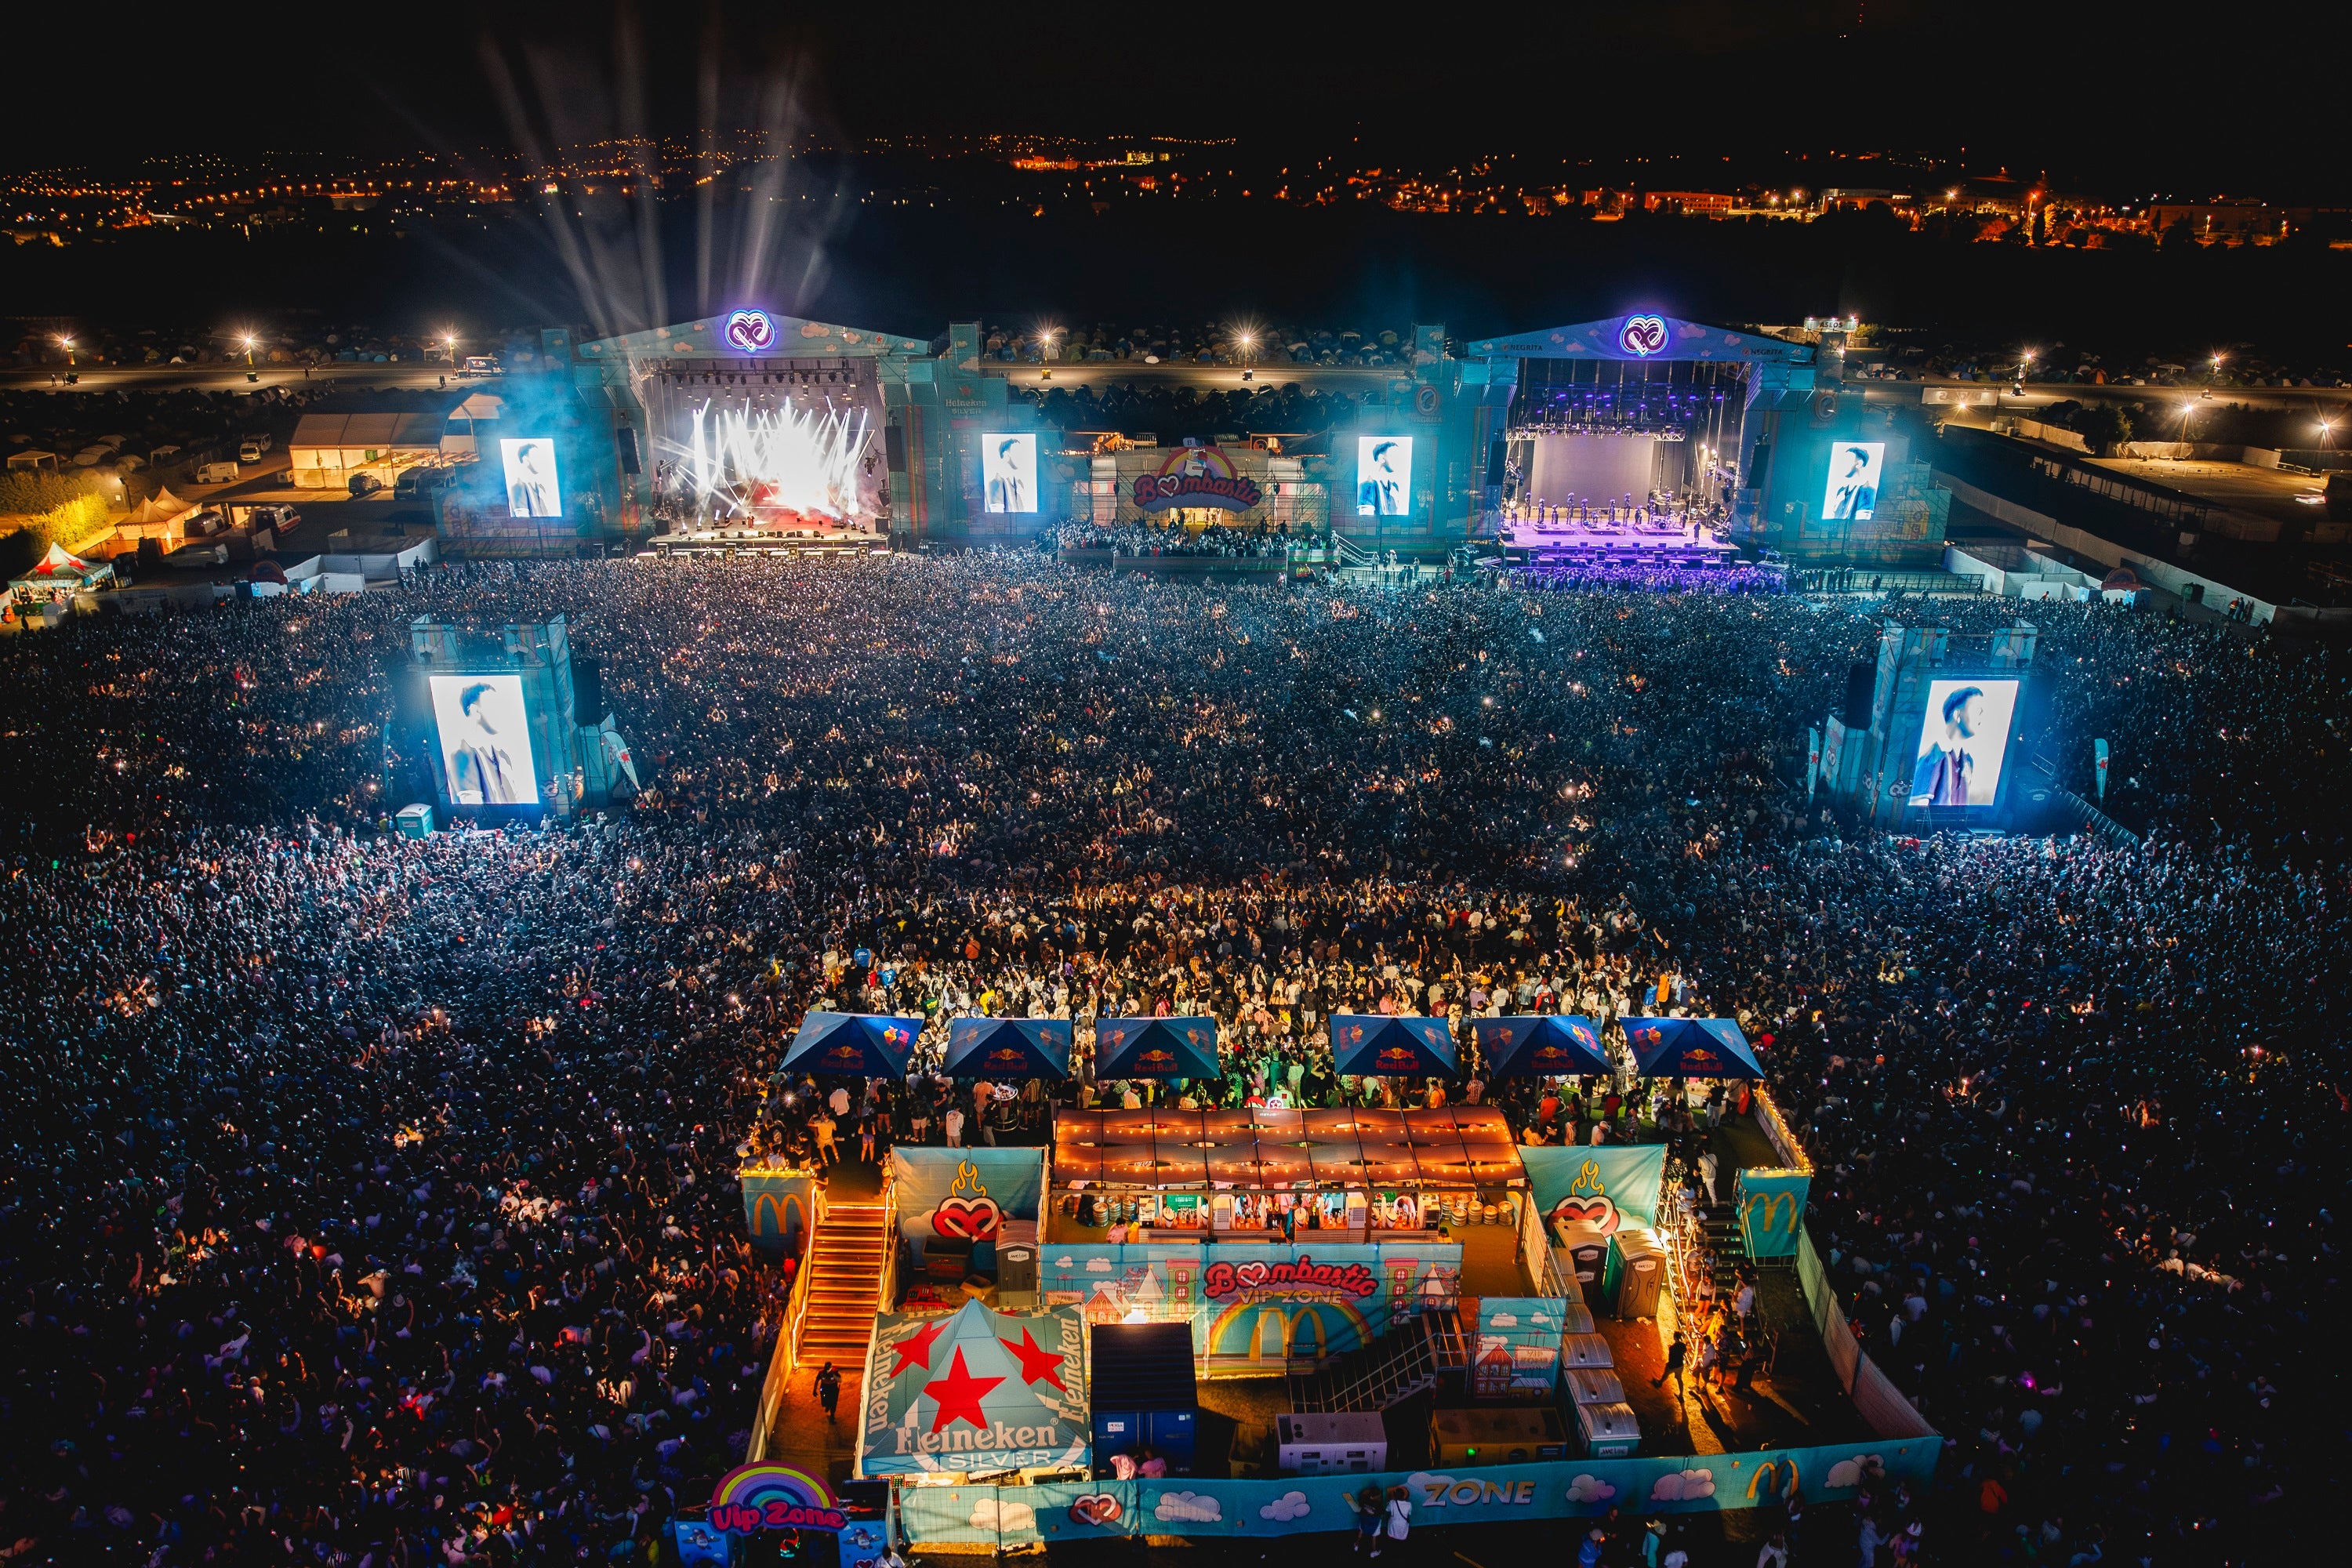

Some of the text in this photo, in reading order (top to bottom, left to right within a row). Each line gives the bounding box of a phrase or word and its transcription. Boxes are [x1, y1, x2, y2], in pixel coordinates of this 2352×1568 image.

[1134, 469, 1262, 507] Bombastic
[1134, 1063, 1178, 1072] Red Bull
[1375, 1060, 1419, 1069] Red Bull
[1680, 1062, 1722, 1071] Red Bull
[1205, 1255, 1377, 1298] Bombastic
[1237, 1290, 1343, 1305] VIP ZONE
[1058, 1317, 1086, 1424] Heineken
[949, 1450, 1051, 1468] SILVER
[1422, 1480, 1535, 1507] ZONE
[713, 1501, 845, 1532] Vip Zone
